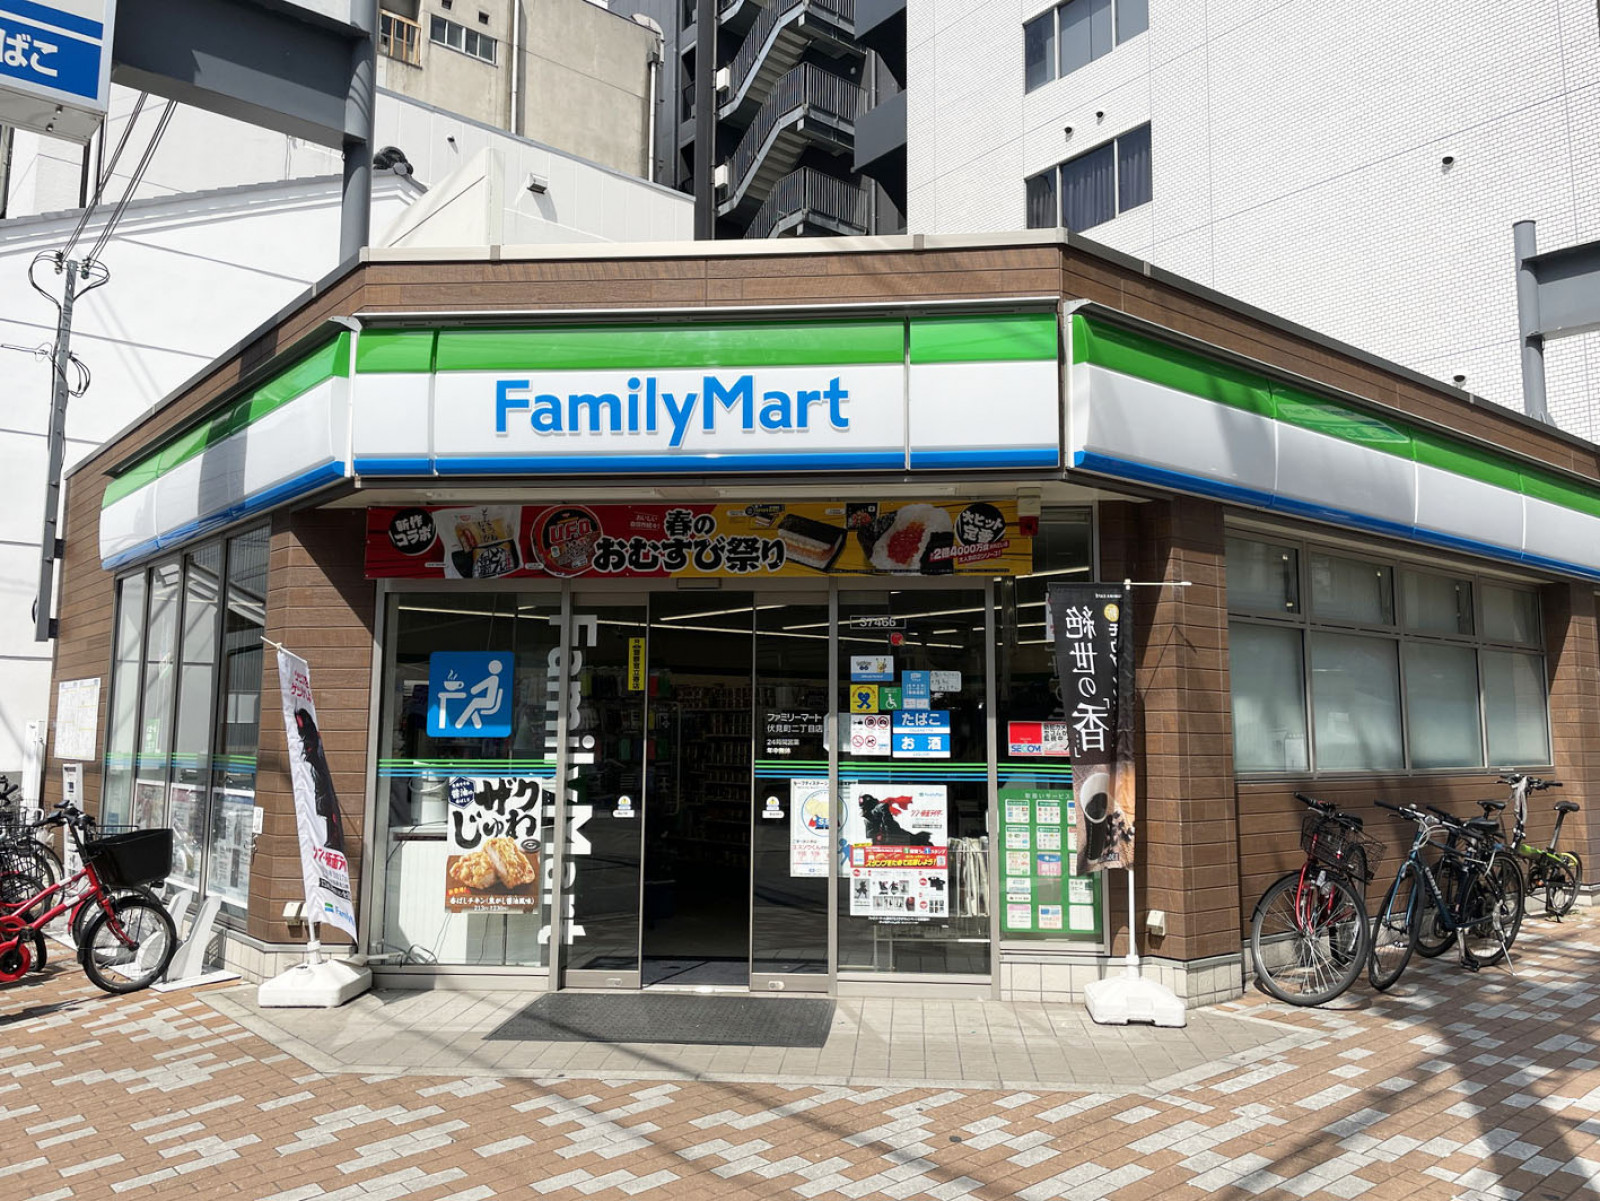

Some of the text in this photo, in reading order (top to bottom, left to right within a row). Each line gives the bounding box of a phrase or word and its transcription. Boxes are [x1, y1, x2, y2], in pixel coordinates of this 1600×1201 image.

[496, 375, 850, 447] FamilyMart
[395, 514, 423, 532] 新作
[664, 509, 716, 538] 春の
[961, 510, 1004, 531] 大ヒット
[394, 523, 432, 548] コラボ
[963, 525, 995, 545] 定番
[593, 536, 786, 573] おむすび祭り
[767, 713, 822, 722] ファミリーマート
[767, 724, 823, 733] 伏見町二丁目店
[901, 713, 941, 726] たばこ
[1011, 745, 1041, 753] SECOM
[538, 614, 598, 945] FamilyMart
[474, 777, 539, 816] ザク
[452, 809, 537, 850] じゅわ
